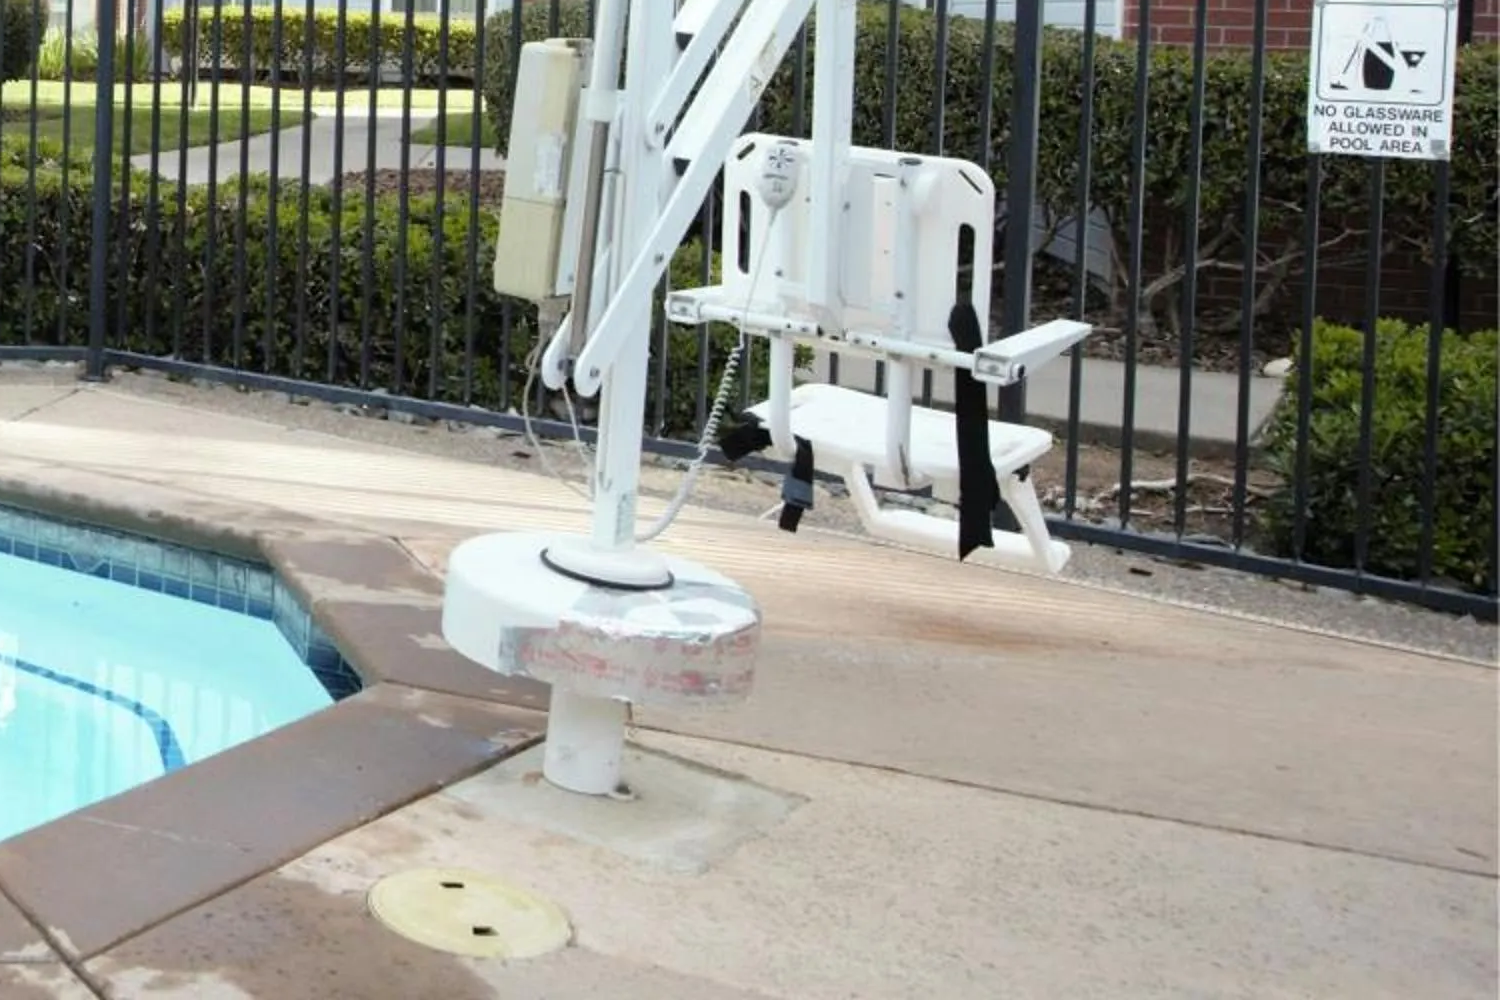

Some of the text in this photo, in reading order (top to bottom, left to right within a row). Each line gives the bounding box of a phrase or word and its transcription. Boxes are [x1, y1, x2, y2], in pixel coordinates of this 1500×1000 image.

[1313, 105, 1444, 123] NO GLASSWARE
[1327, 121, 1428, 138] ALLOWED IN
[1329, 137, 1423, 153] POOL AREA
